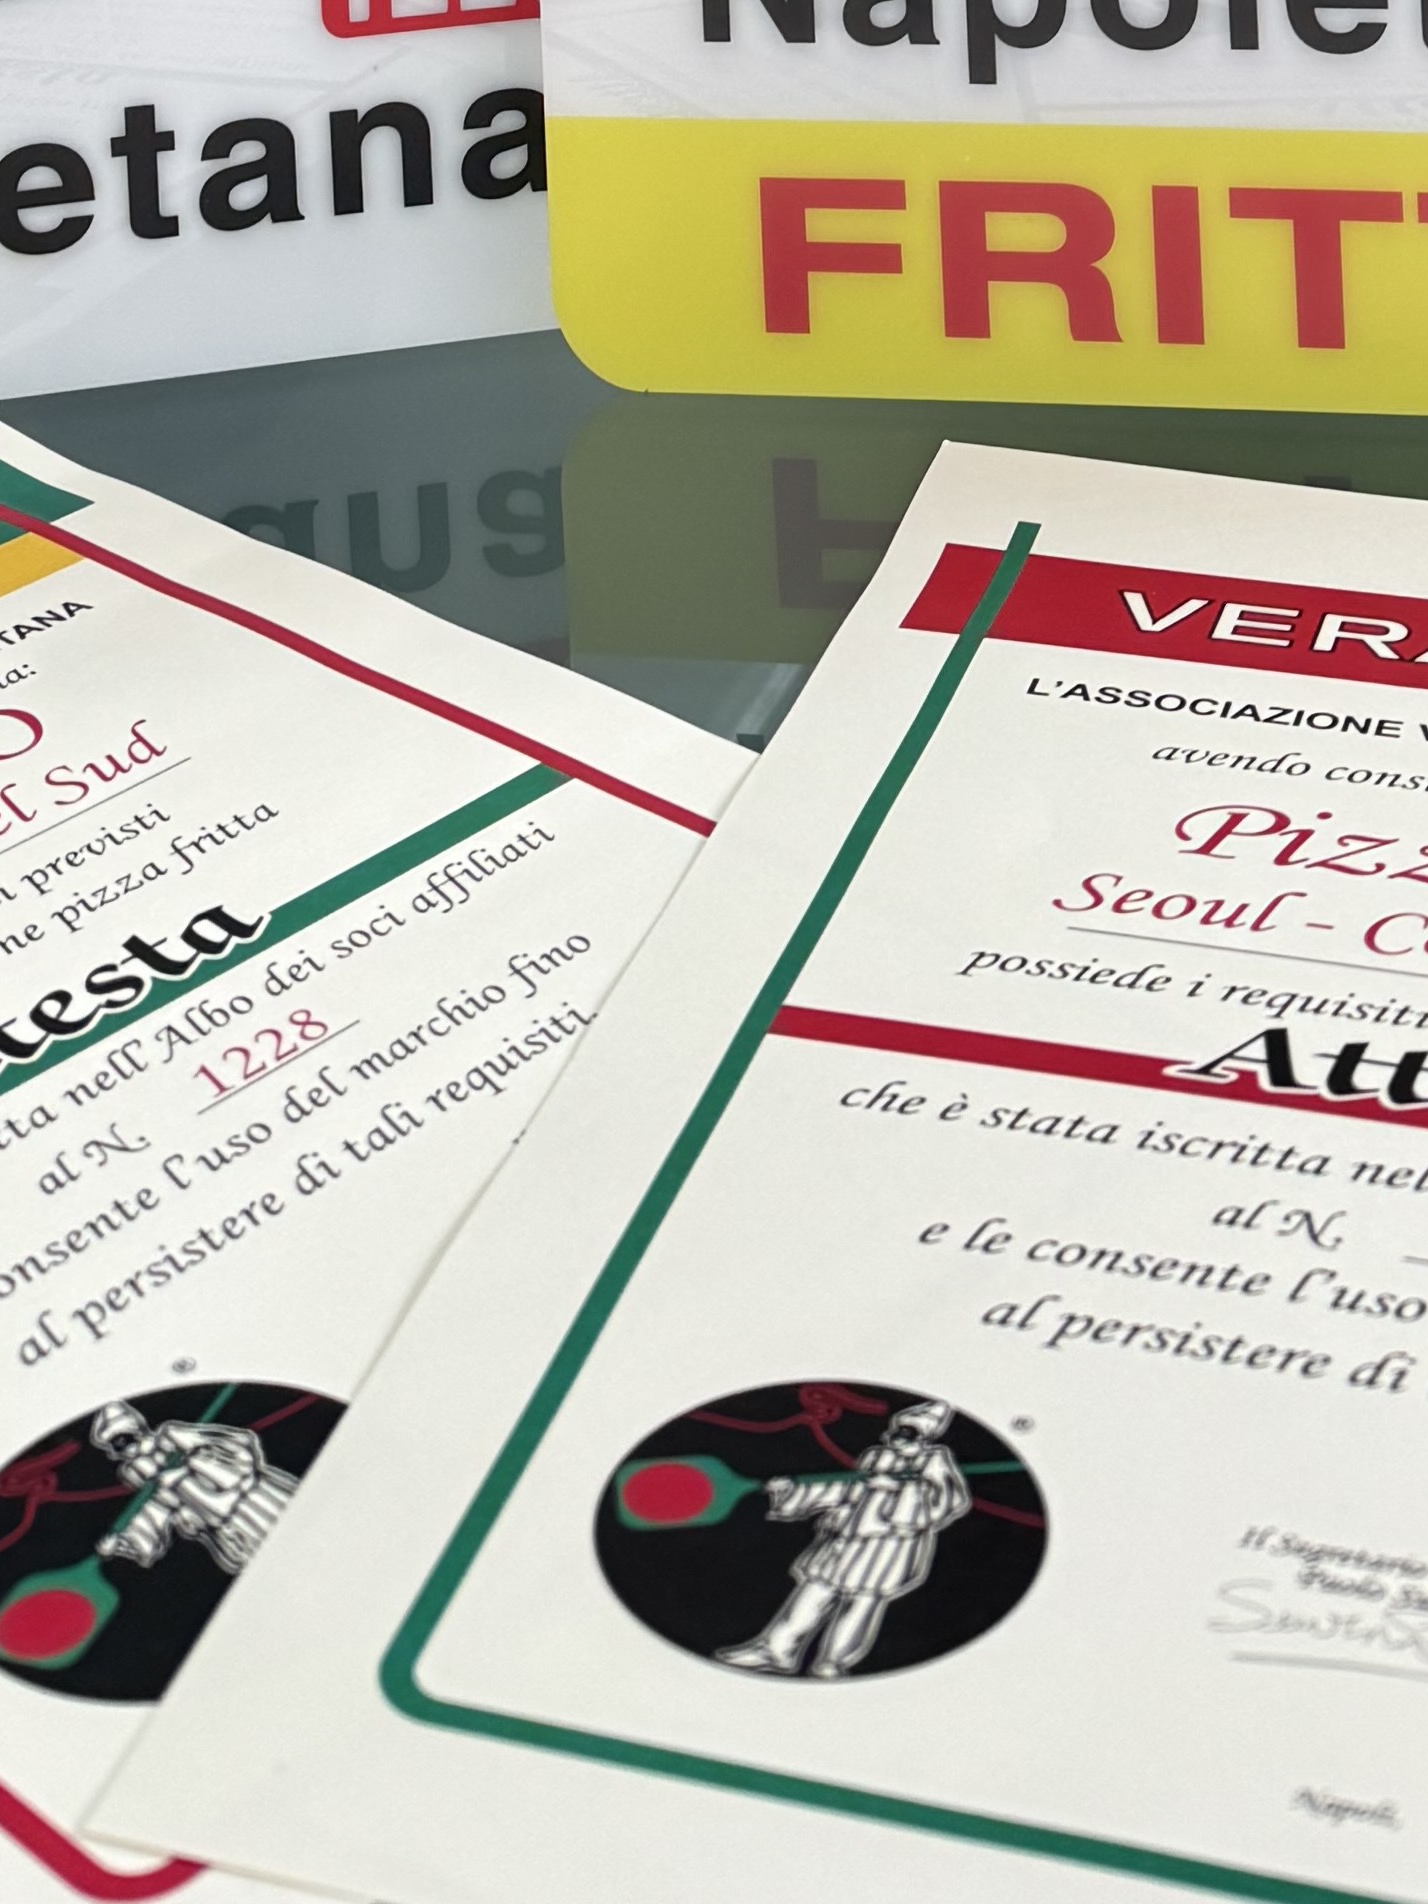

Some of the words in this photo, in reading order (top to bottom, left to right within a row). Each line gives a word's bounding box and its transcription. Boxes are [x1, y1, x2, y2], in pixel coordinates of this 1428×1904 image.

[1025, 676, 1404, 739] L'ASSOCIAZIONE
[43, 717, 168, 806] Sud
[1150, 745, 1312, 777] avendo
[18, 801, 171, 896] previsti
[49, 860, 169, 934] pizza
[169, 802, 280, 876] fritta
[263, 948, 326, 997] dei
[328, 903, 407, 960] soci
[410, 820, 556, 914] affiliati
[1050, 871, 1301, 933] Seoul
[955, 949, 1173, 993] possiede
[282, 1064, 348, 1124] del
[347, 983, 507, 1081] marchio
[506, 933, 591, 999] fino
[37, 1149, 81, 1196] al
[192, 1007, 333, 1105] 1228
[838, 1079, 927, 1116] che
[978, 1106, 1120, 1145] stata
[1135, 1119, 1332, 1177] iscritta
[17, 1308, 67, 1367] al
[70, 1191, 285, 1341] persistere
[293, 1150, 342, 1197] di
[341, 1100, 425, 1163] tali
[424, 1000, 599, 1113] requisiti.
[1210, 1198, 1278, 1231] al
[961, 1216, 1013, 1255] le
[1025, 1238, 1272, 1296] consente
[979, 1293, 1062, 1331] al
[1043, 1311, 1332, 1379] persistere
[1346, 1350, 1416, 1394] di
